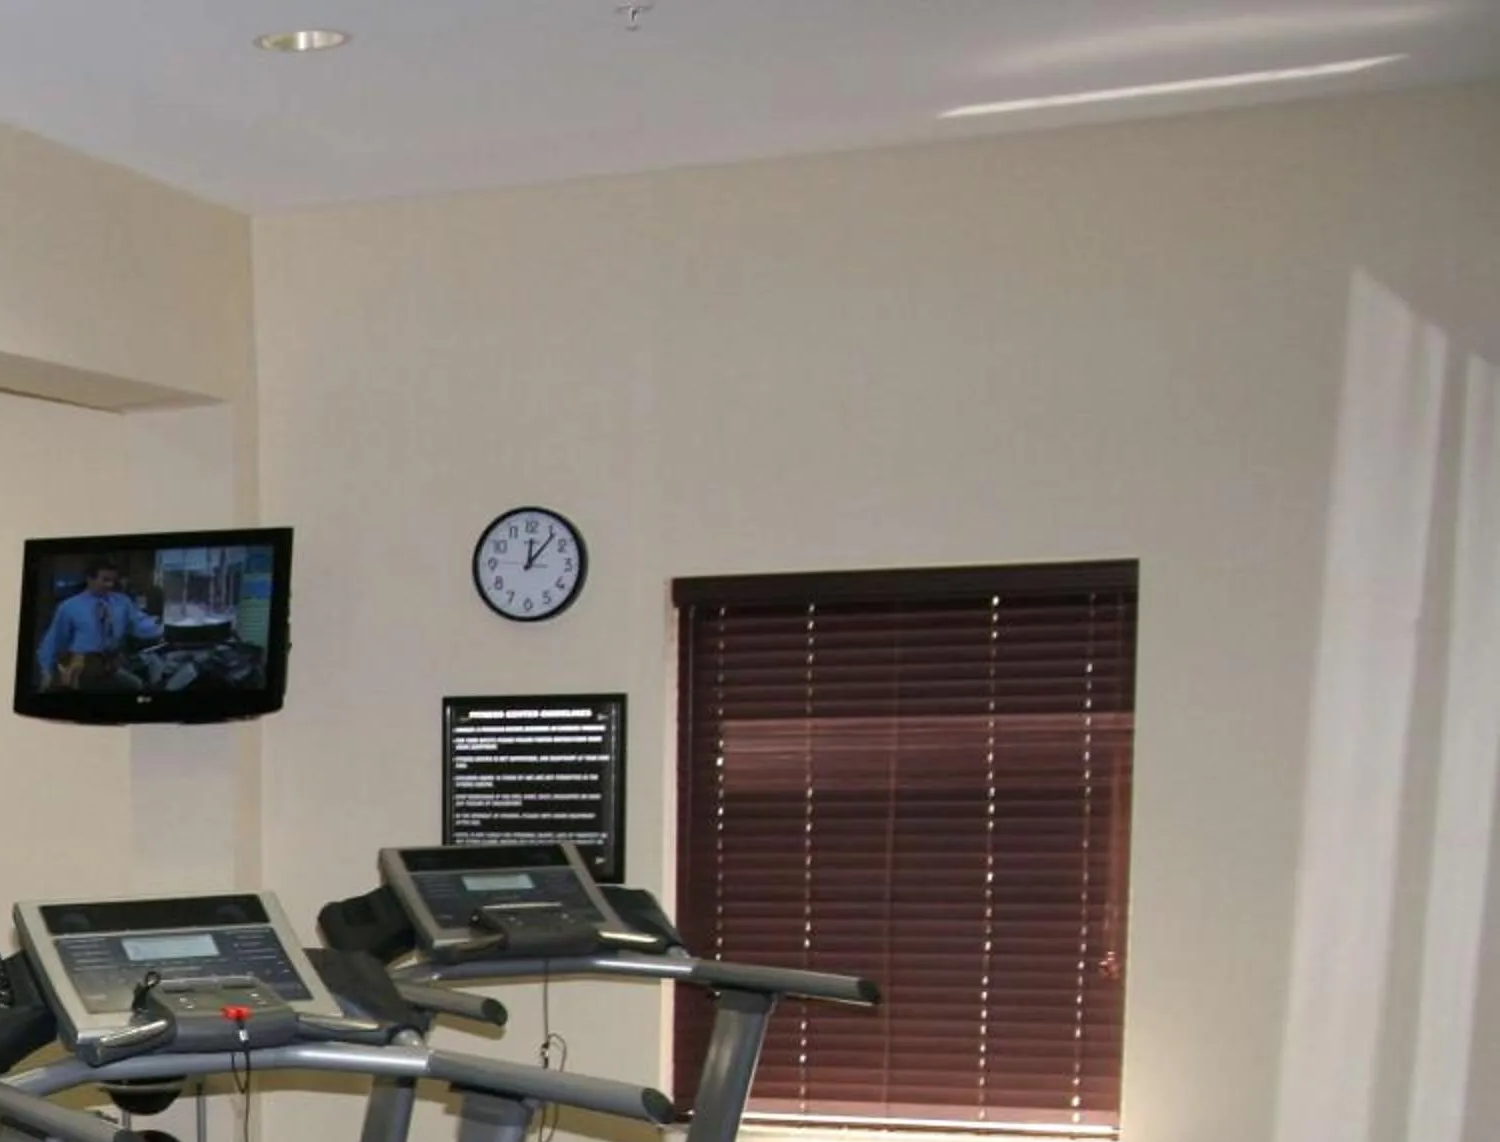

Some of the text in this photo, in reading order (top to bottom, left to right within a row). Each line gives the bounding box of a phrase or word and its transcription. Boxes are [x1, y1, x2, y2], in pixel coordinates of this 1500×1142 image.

[509, 526, 519, 539] 11
[525, 520, 539, 533] 12
[493, 540, 508, 554] 10
[557, 539, 567, 553] 2
[487, 556, 498, 571] 9
[564, 557, 573, 572] 3
[494, 576, 504, 590] 8
[555, 576, 565, 589] 4
[506, 590, 515, 604] 7
[542, 590, 552, 605] 5
